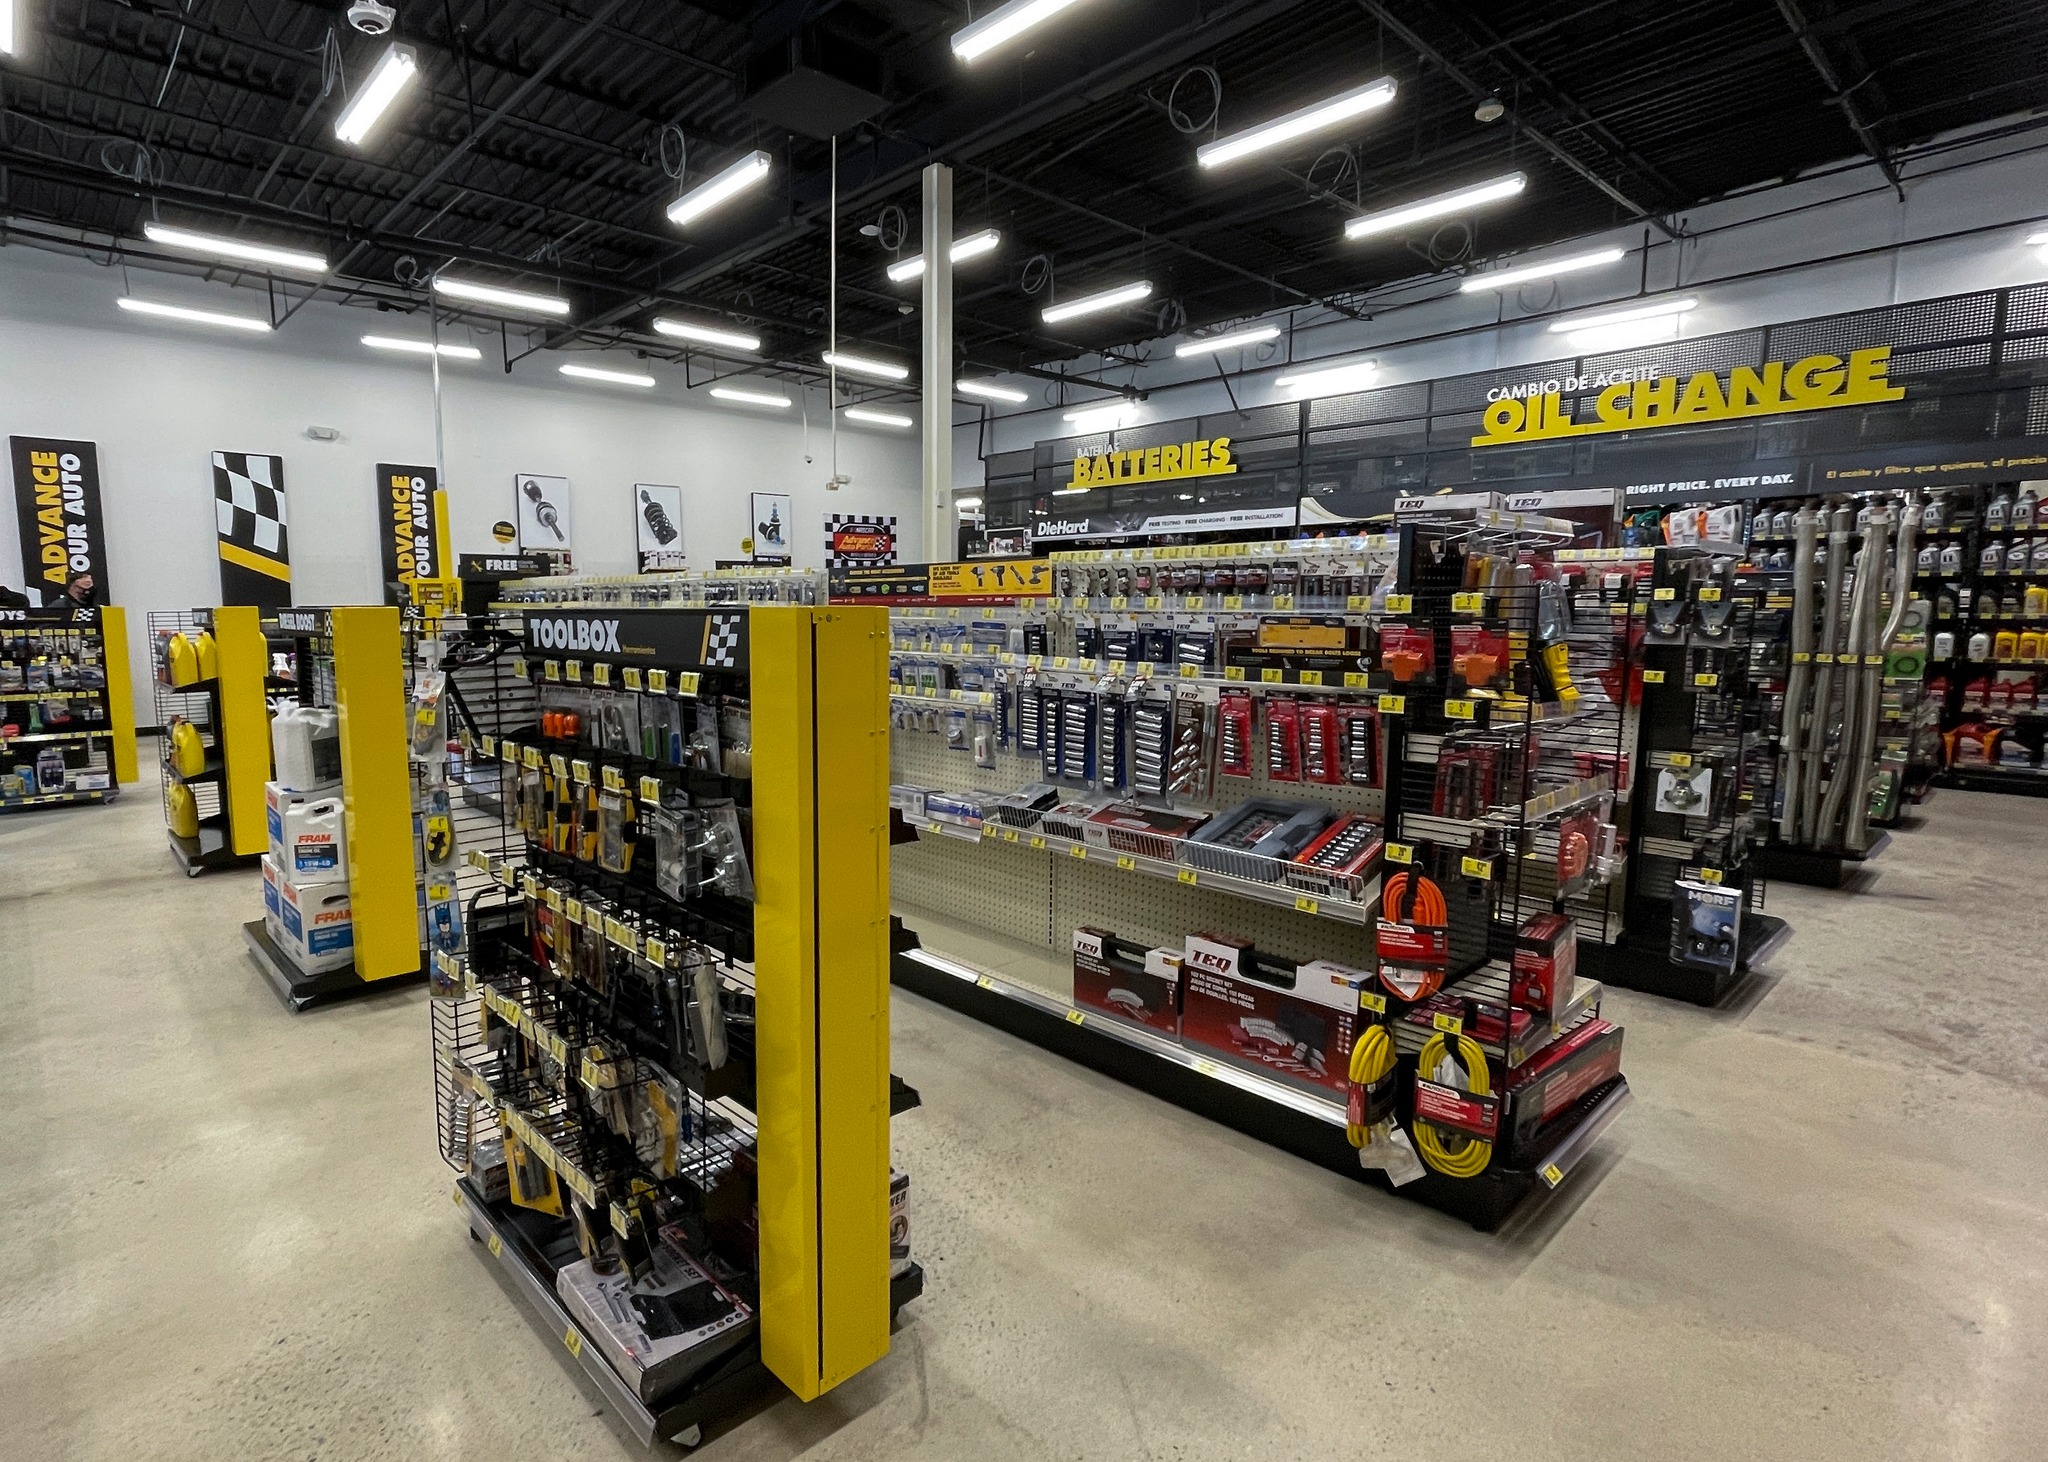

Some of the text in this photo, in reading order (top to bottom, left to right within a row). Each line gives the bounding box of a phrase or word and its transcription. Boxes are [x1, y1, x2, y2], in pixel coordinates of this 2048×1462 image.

[1487, 365, 1660, 403] CAMBIO DE ACEITE
[1472, 346, 1905, 447] OIL CHANGE
[1067, 437, 1237, 490] BATTERIES
[1826, 470, 1837, 479] El
[1874, 469, 1881, 477] y
[1627, 473, 1794, 496] RIGHT PRICE. EVERY DAY.
[411, 477, 428, 529] AUTO
[1399, 500, 1424, 509] TEQ
[1513, 498, 1542, 507] TEQ
[30, 451, 68, 585] ADVANCE
[59, 453, 91, 574] OUR AUTO
[1245, 513, 1284, 521] INSTALLATION
[391, 475, 415, 585] ADVANCE
[1037, 519, 1089, 537] DieHard
[485, 559, 518, 571] FREE
[296, 614, 315, 631] BOOST
[530, 618, 621, 653] TOOLBOX
[298, 834, 331, 843] FRAM
[1076, 941, 1098, 955] TEQ
[1192, 950, 1231, 971] TEQ
[684, 1266, 703, 1280] SET
